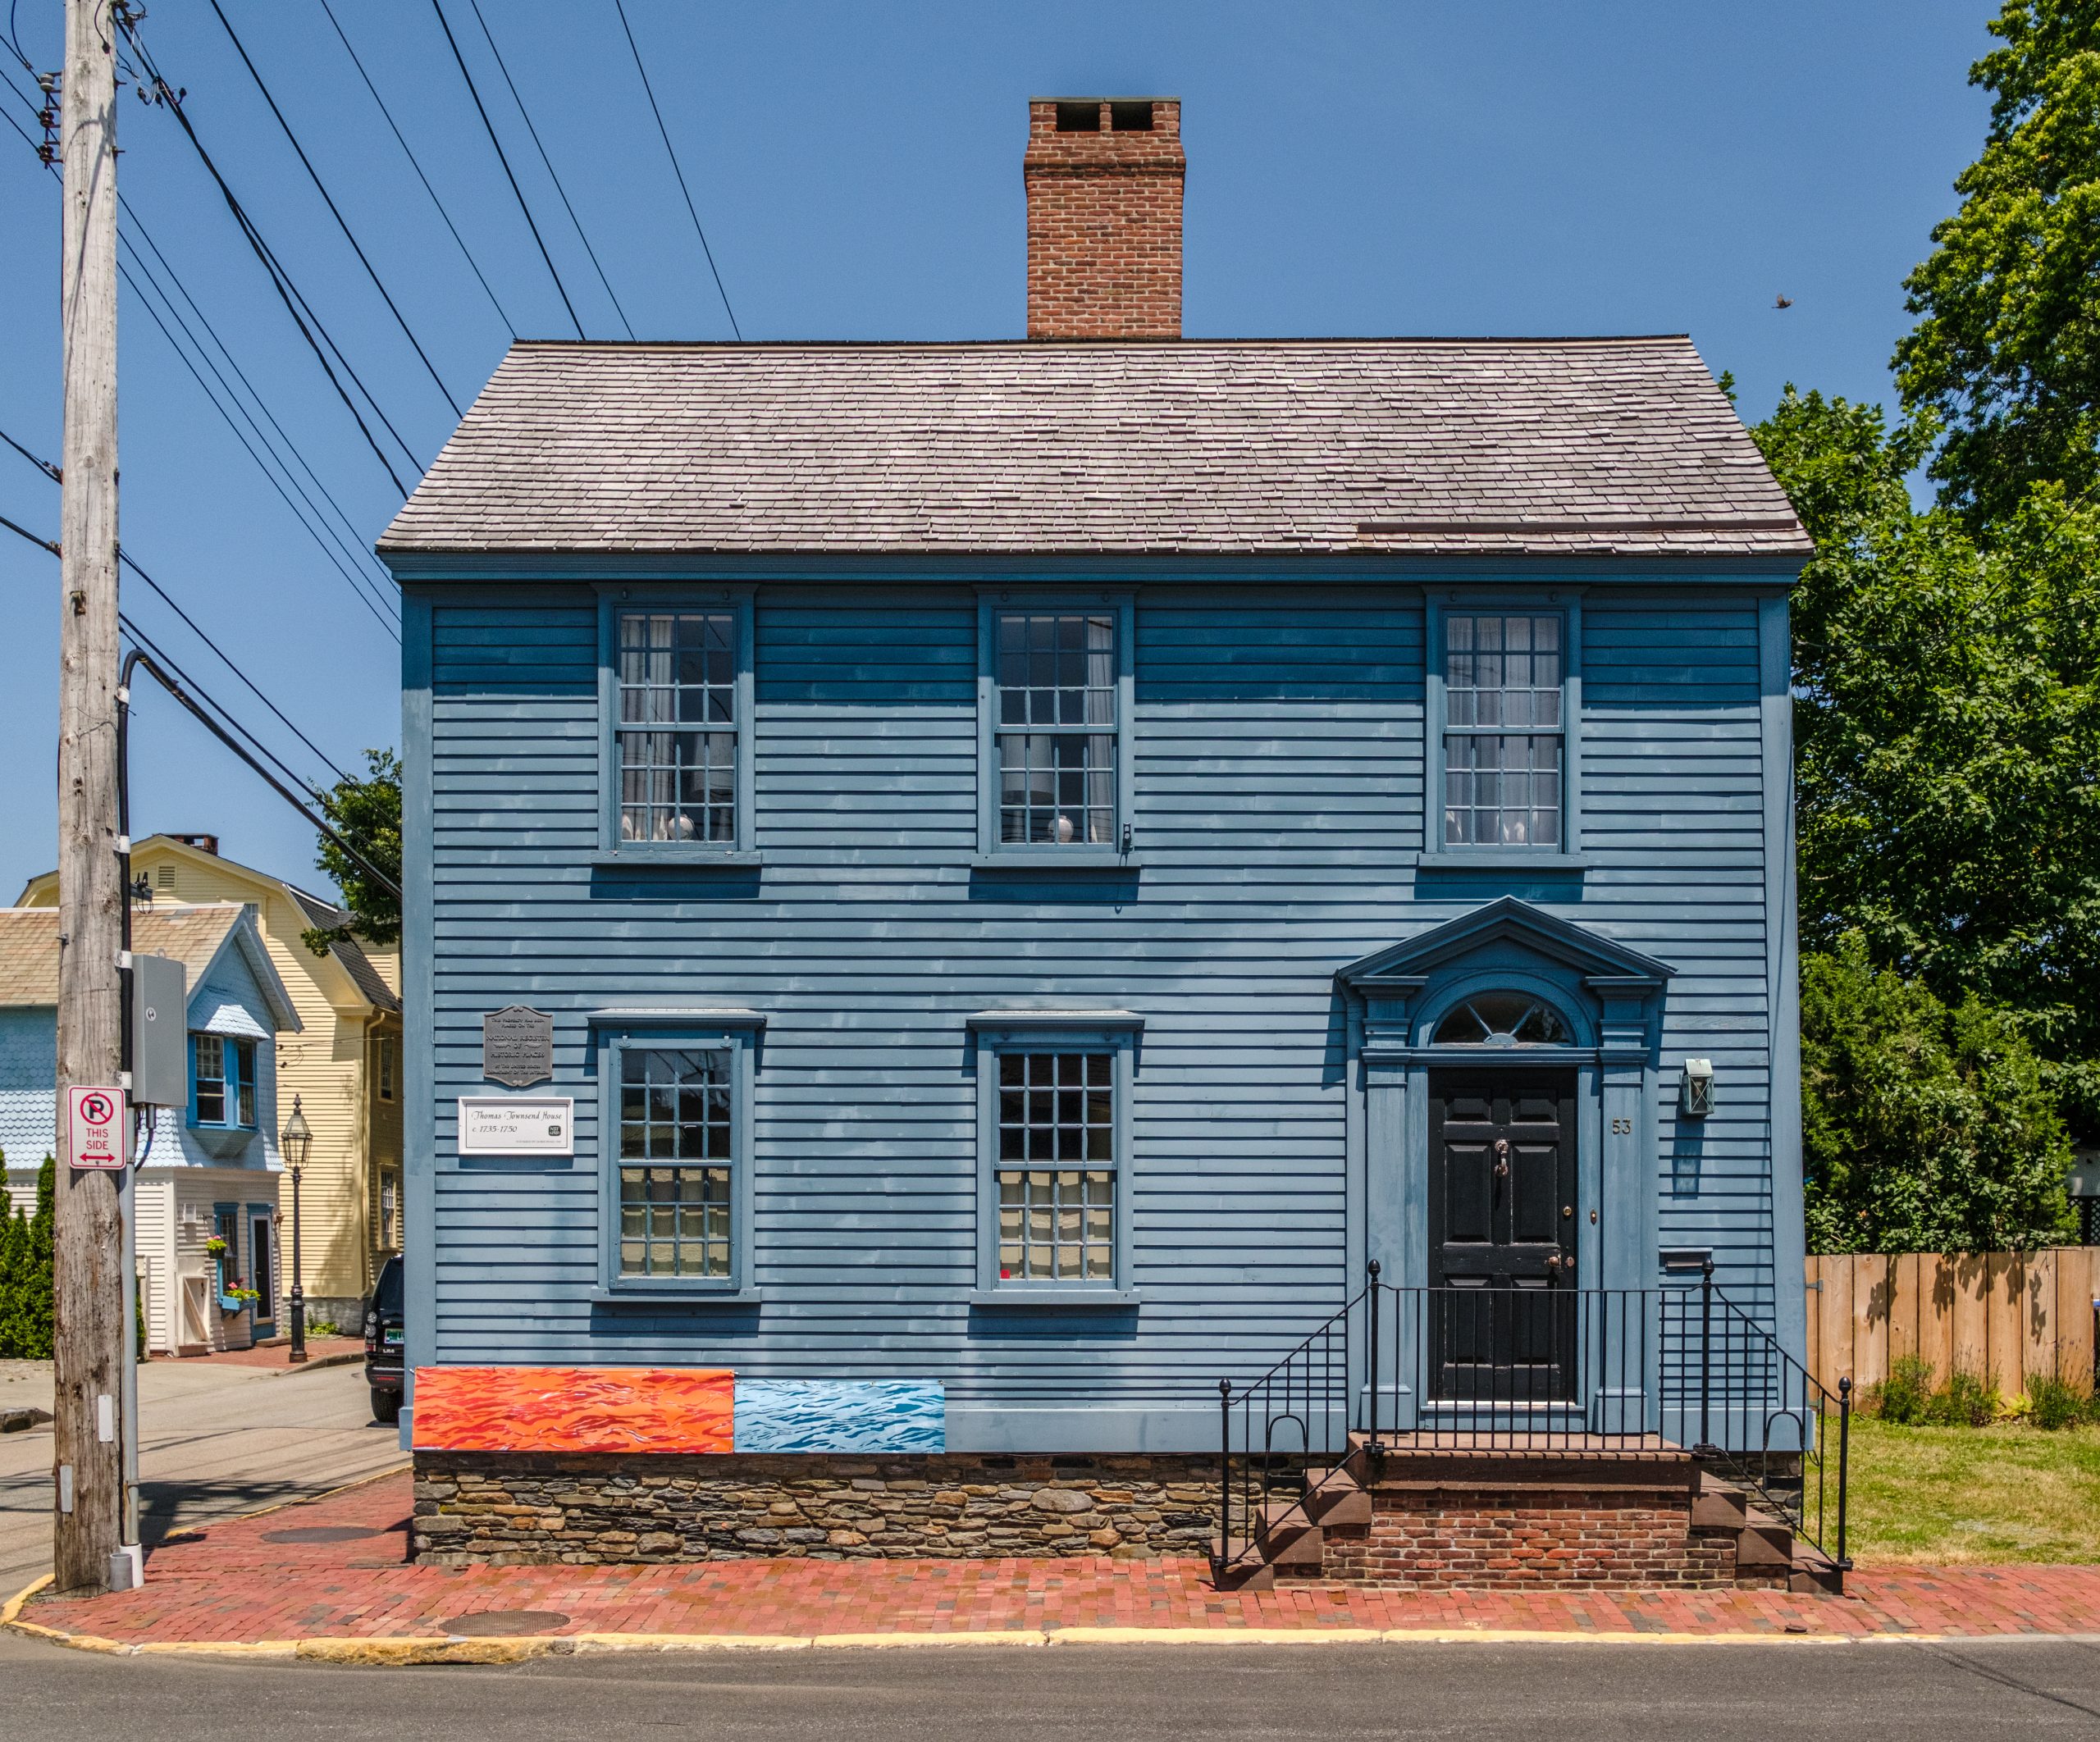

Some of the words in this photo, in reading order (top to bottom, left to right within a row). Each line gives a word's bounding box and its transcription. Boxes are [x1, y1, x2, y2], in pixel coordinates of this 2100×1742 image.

[472, 1110, 501, 1120] Thomas
[504, 1110, 541, 1120] Townsend
[541, 1111, 562, 1121] House
[1613, 1119, 1631, 1135] 53
[86, 1128, 108, 1138] THIS
[86, 1140, 108, 1150] SIDE
